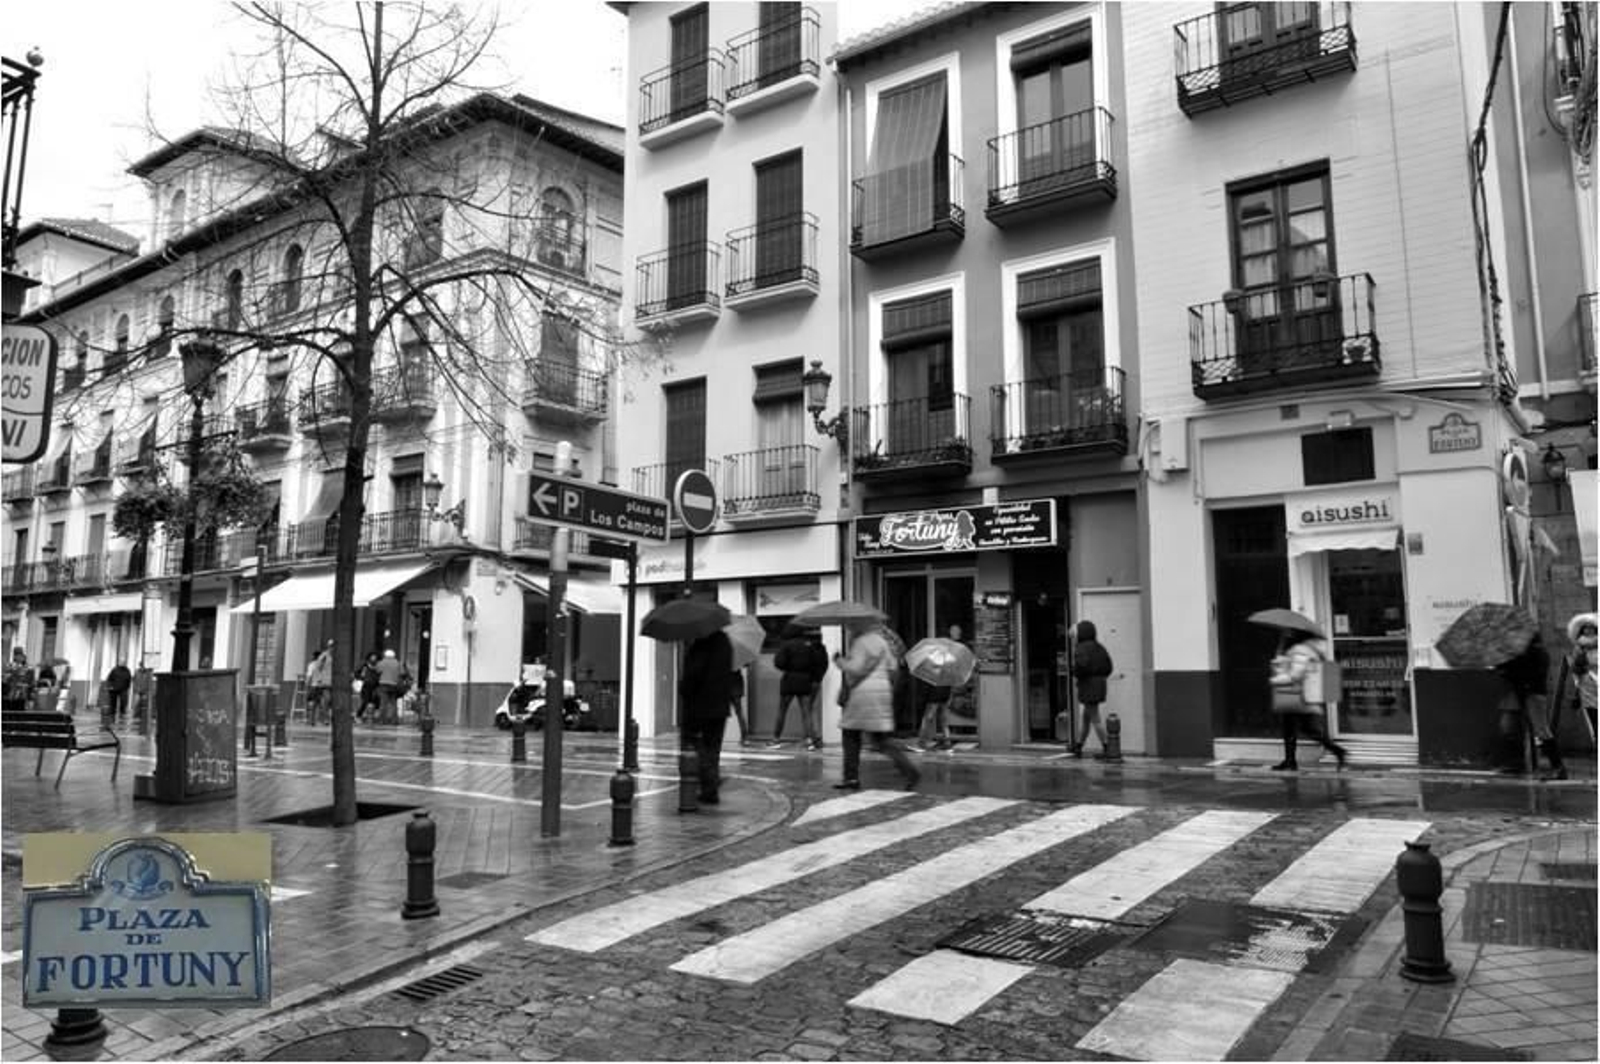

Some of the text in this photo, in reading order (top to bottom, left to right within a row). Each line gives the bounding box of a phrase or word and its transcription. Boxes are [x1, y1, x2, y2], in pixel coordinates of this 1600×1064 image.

[563, 490, 580, 515] P
[626, 501, 665, 518] plaza de
[1301, 499, 1389, 523] aisushi
[590, 509, 664, 537] Los Campos
[882, 512, 960, 550] Fortuny
[79, 907, 210, 931] PLAZA
[126, 933, 162, 946] DE
[35, 951, 250, 994] FORTUNY
